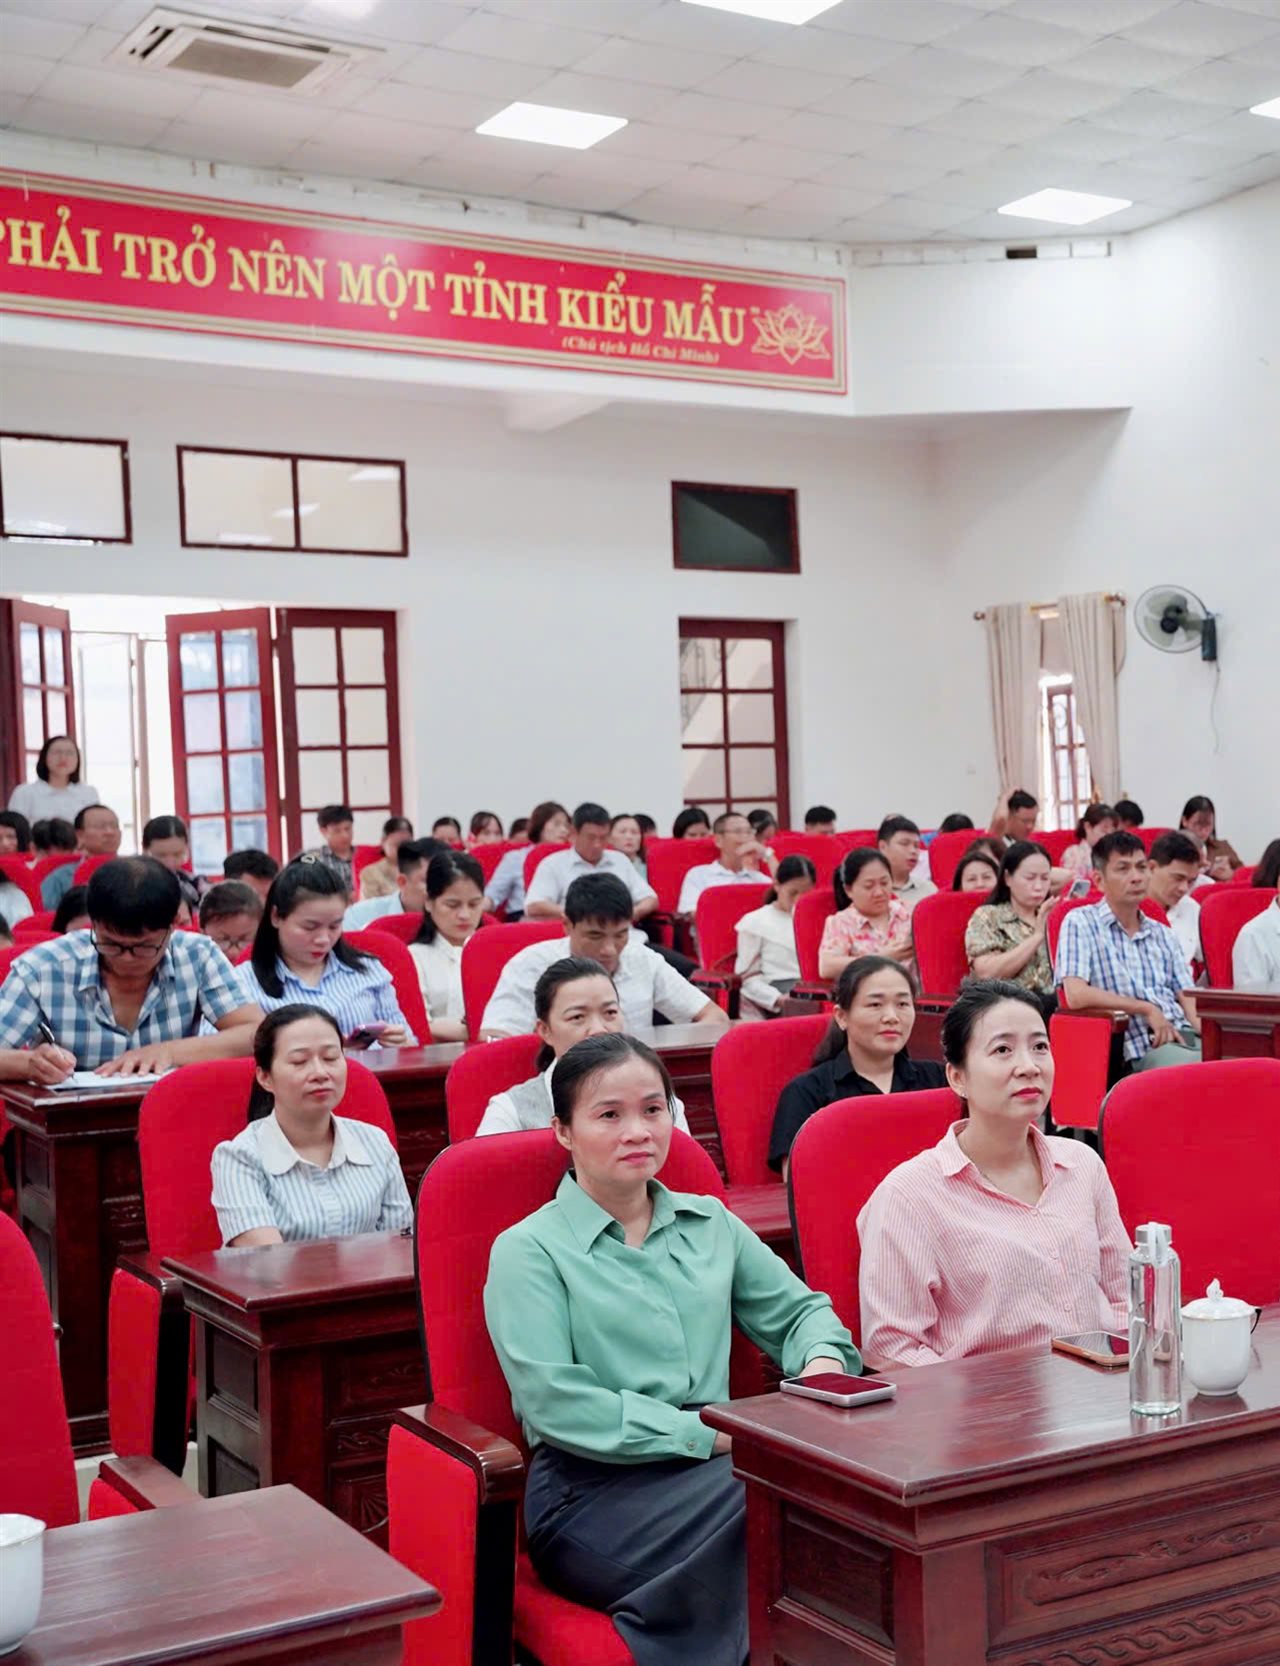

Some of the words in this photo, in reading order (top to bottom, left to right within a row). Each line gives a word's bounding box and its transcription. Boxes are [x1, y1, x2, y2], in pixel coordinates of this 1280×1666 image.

[0, 205, 102, 274] HẢI
[114, 225, 216, 287] TRỞ
[228, 239, 327, 300] NÊN
[337, 253, 435, 321] MỘT
[444, 261, 548, 325] TỈNH
[557, 271, 654, 337] KIỂU
